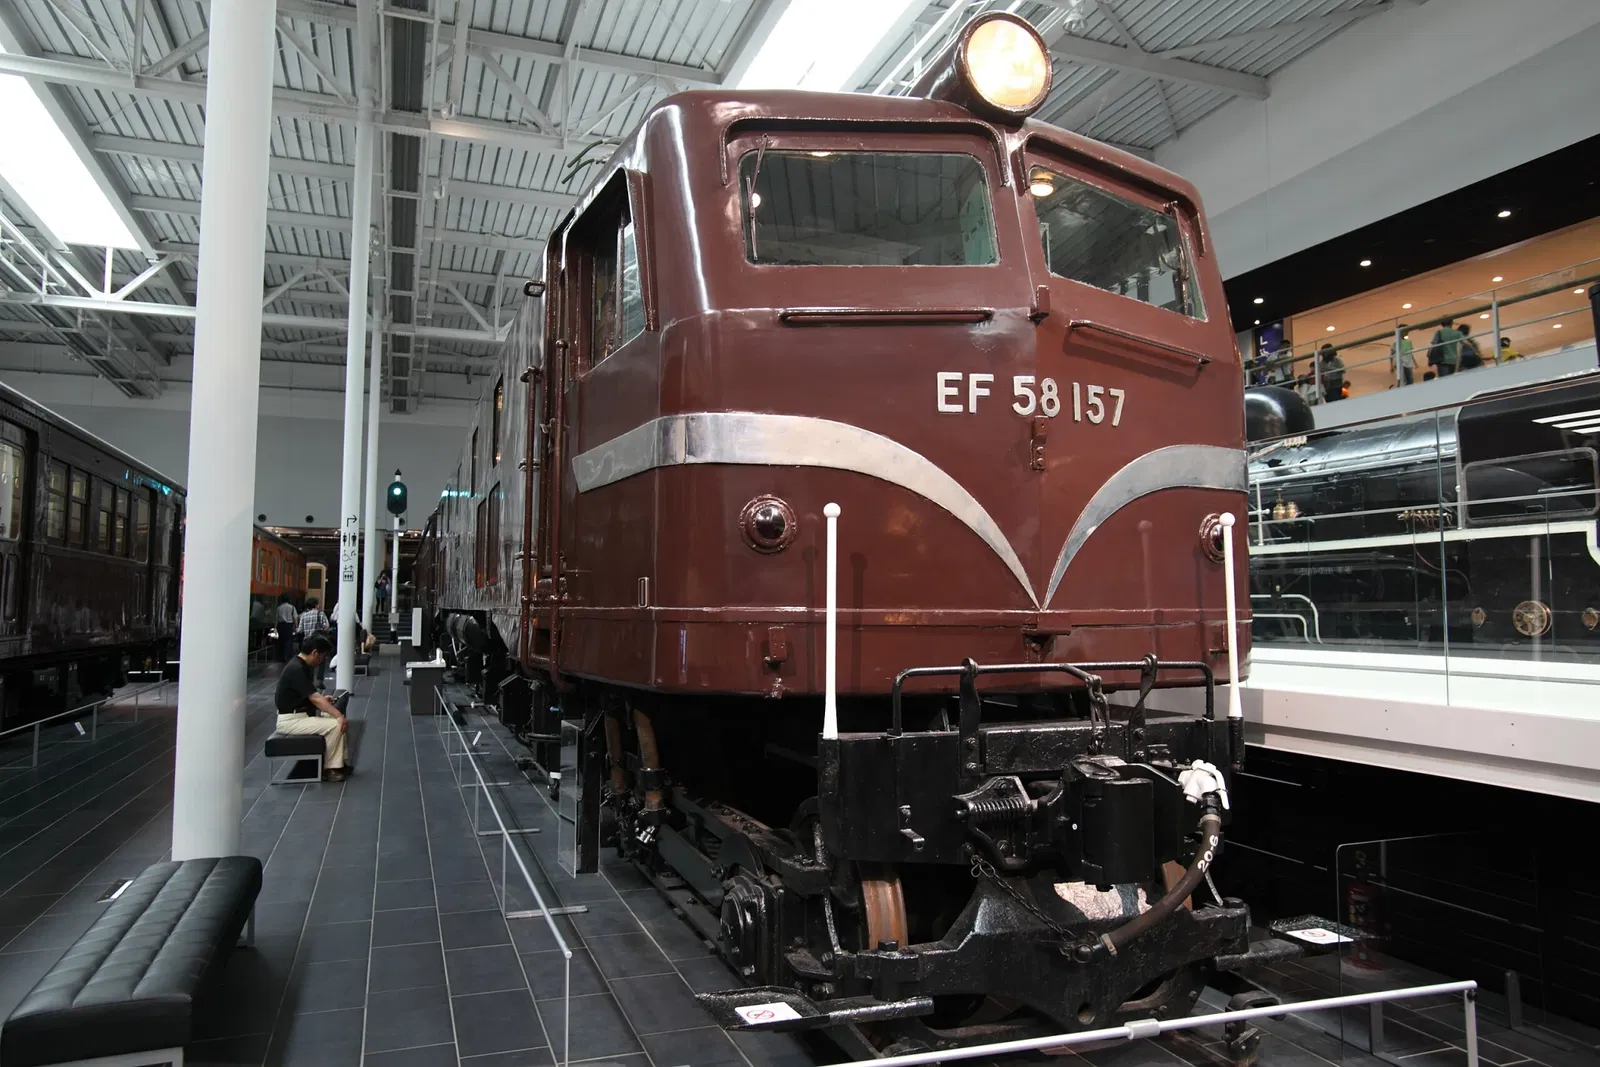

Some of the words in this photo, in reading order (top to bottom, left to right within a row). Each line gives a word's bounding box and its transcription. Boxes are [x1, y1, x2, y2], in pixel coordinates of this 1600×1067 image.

[937, 371, 994, 414] EF
[1012, 375, 1061, 417] 58
[1072, 381, 1125, 427] 157
